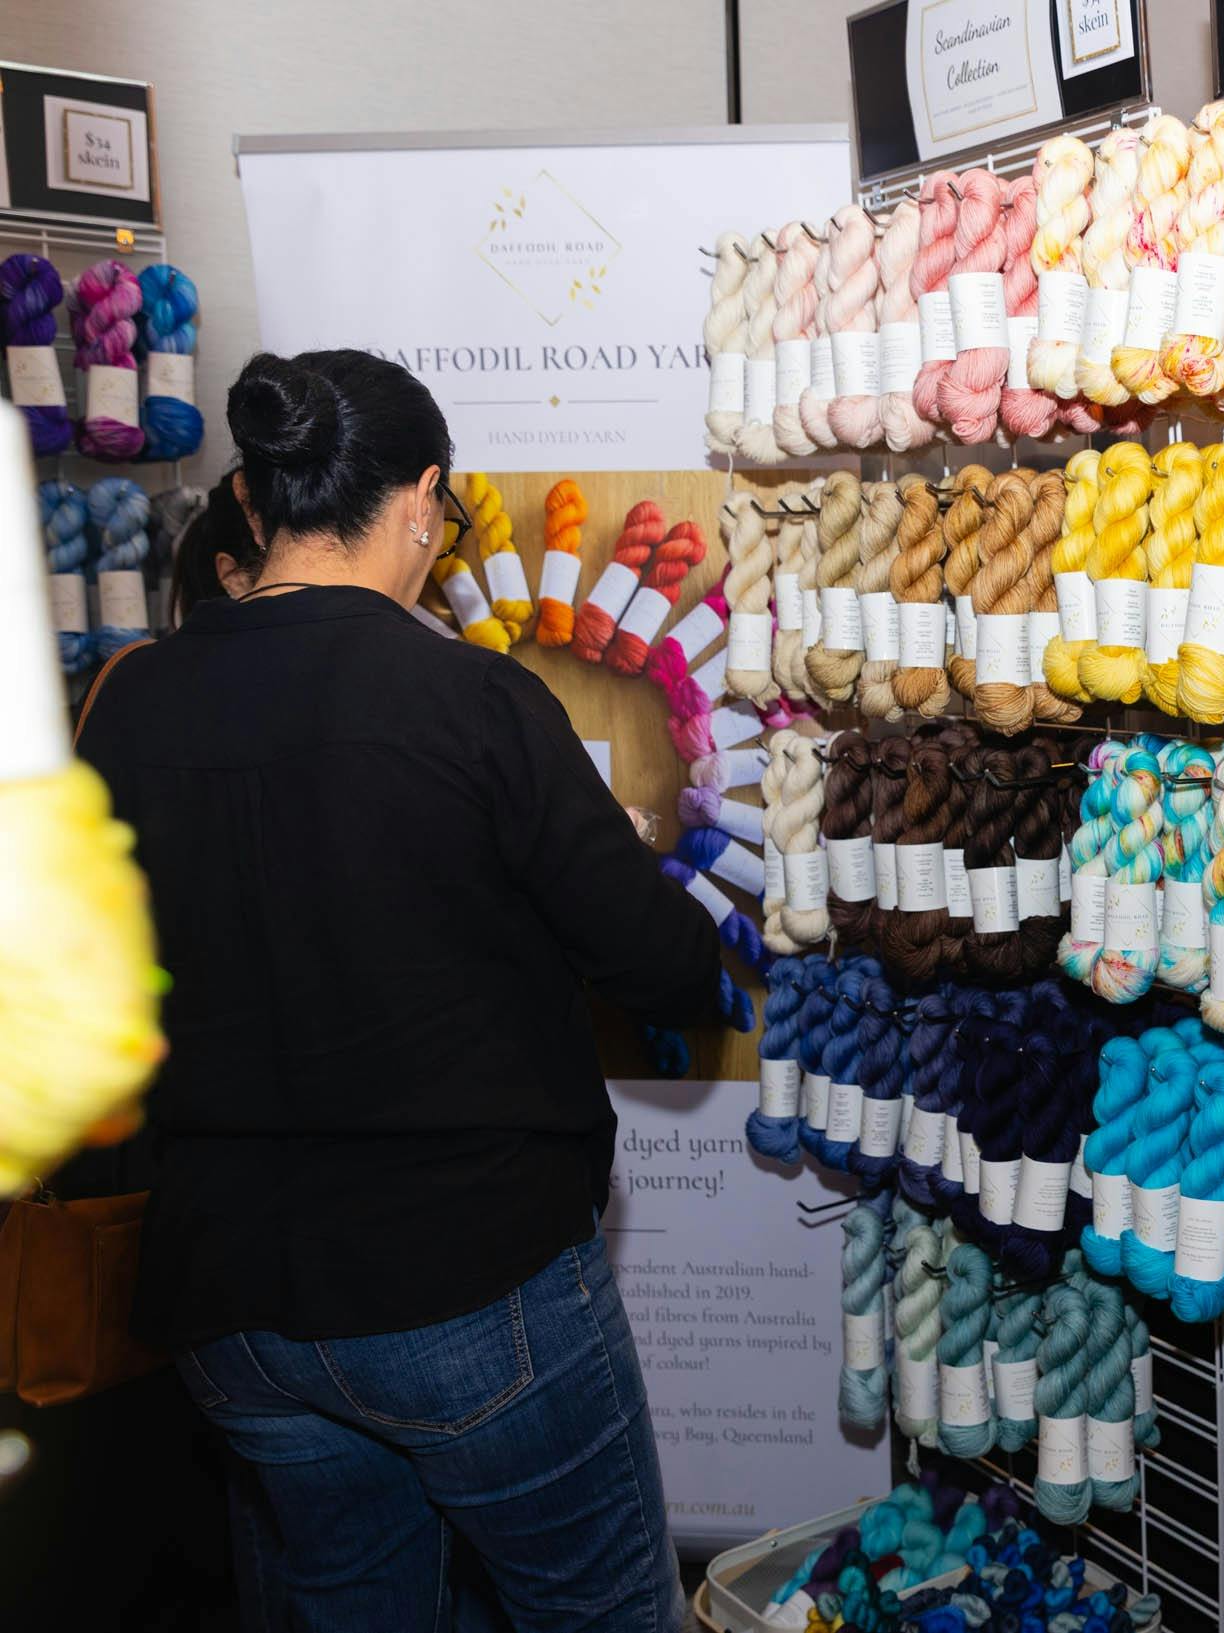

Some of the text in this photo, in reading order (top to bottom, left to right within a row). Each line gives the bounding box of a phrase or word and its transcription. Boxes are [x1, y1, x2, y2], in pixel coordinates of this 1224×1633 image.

[1077, 10, 1109, 35] skein
[934, 14, 1012, 56] Scandinavian
[946, 58, 1000, 90] Collection
[85, 131, 112, 150] $34
[77, 150, 120, 170] skein
[490, 240, 604, 254] DAFFODIL ROAD
[542, 343, 637, 371] ROAD
[646, 343, 709, 370] YAR
[488, 428, 626, 447] HAND DYED YARN
[623, 1128, 744, 1160] dyed yarn
[629, 1169, 725, 1198] journey!
[682, 1260, 766, 1278] Australian
[768, 1260, 816, 1278] hand-
[696, 1281, 711, 1299] in
[715, 1284, 755, 1301] 2019.
[629, 1304, 816, 1326] ral fibres from Australia
[632, 1329, 832, 1357] nd dyed yarns inspired by
[655, 1354, 711, 1371] colour!
[680, 1402, 712, 1417] who
[716, 1402, 767, 1420] resides
[772, 1405, 786, 1420] in
[791, 1405, 816, 1421] the
[654, 1427, 814, 1447] vey Bay, Queensland
[663, 1501, 755, 1517] rn.com.au
